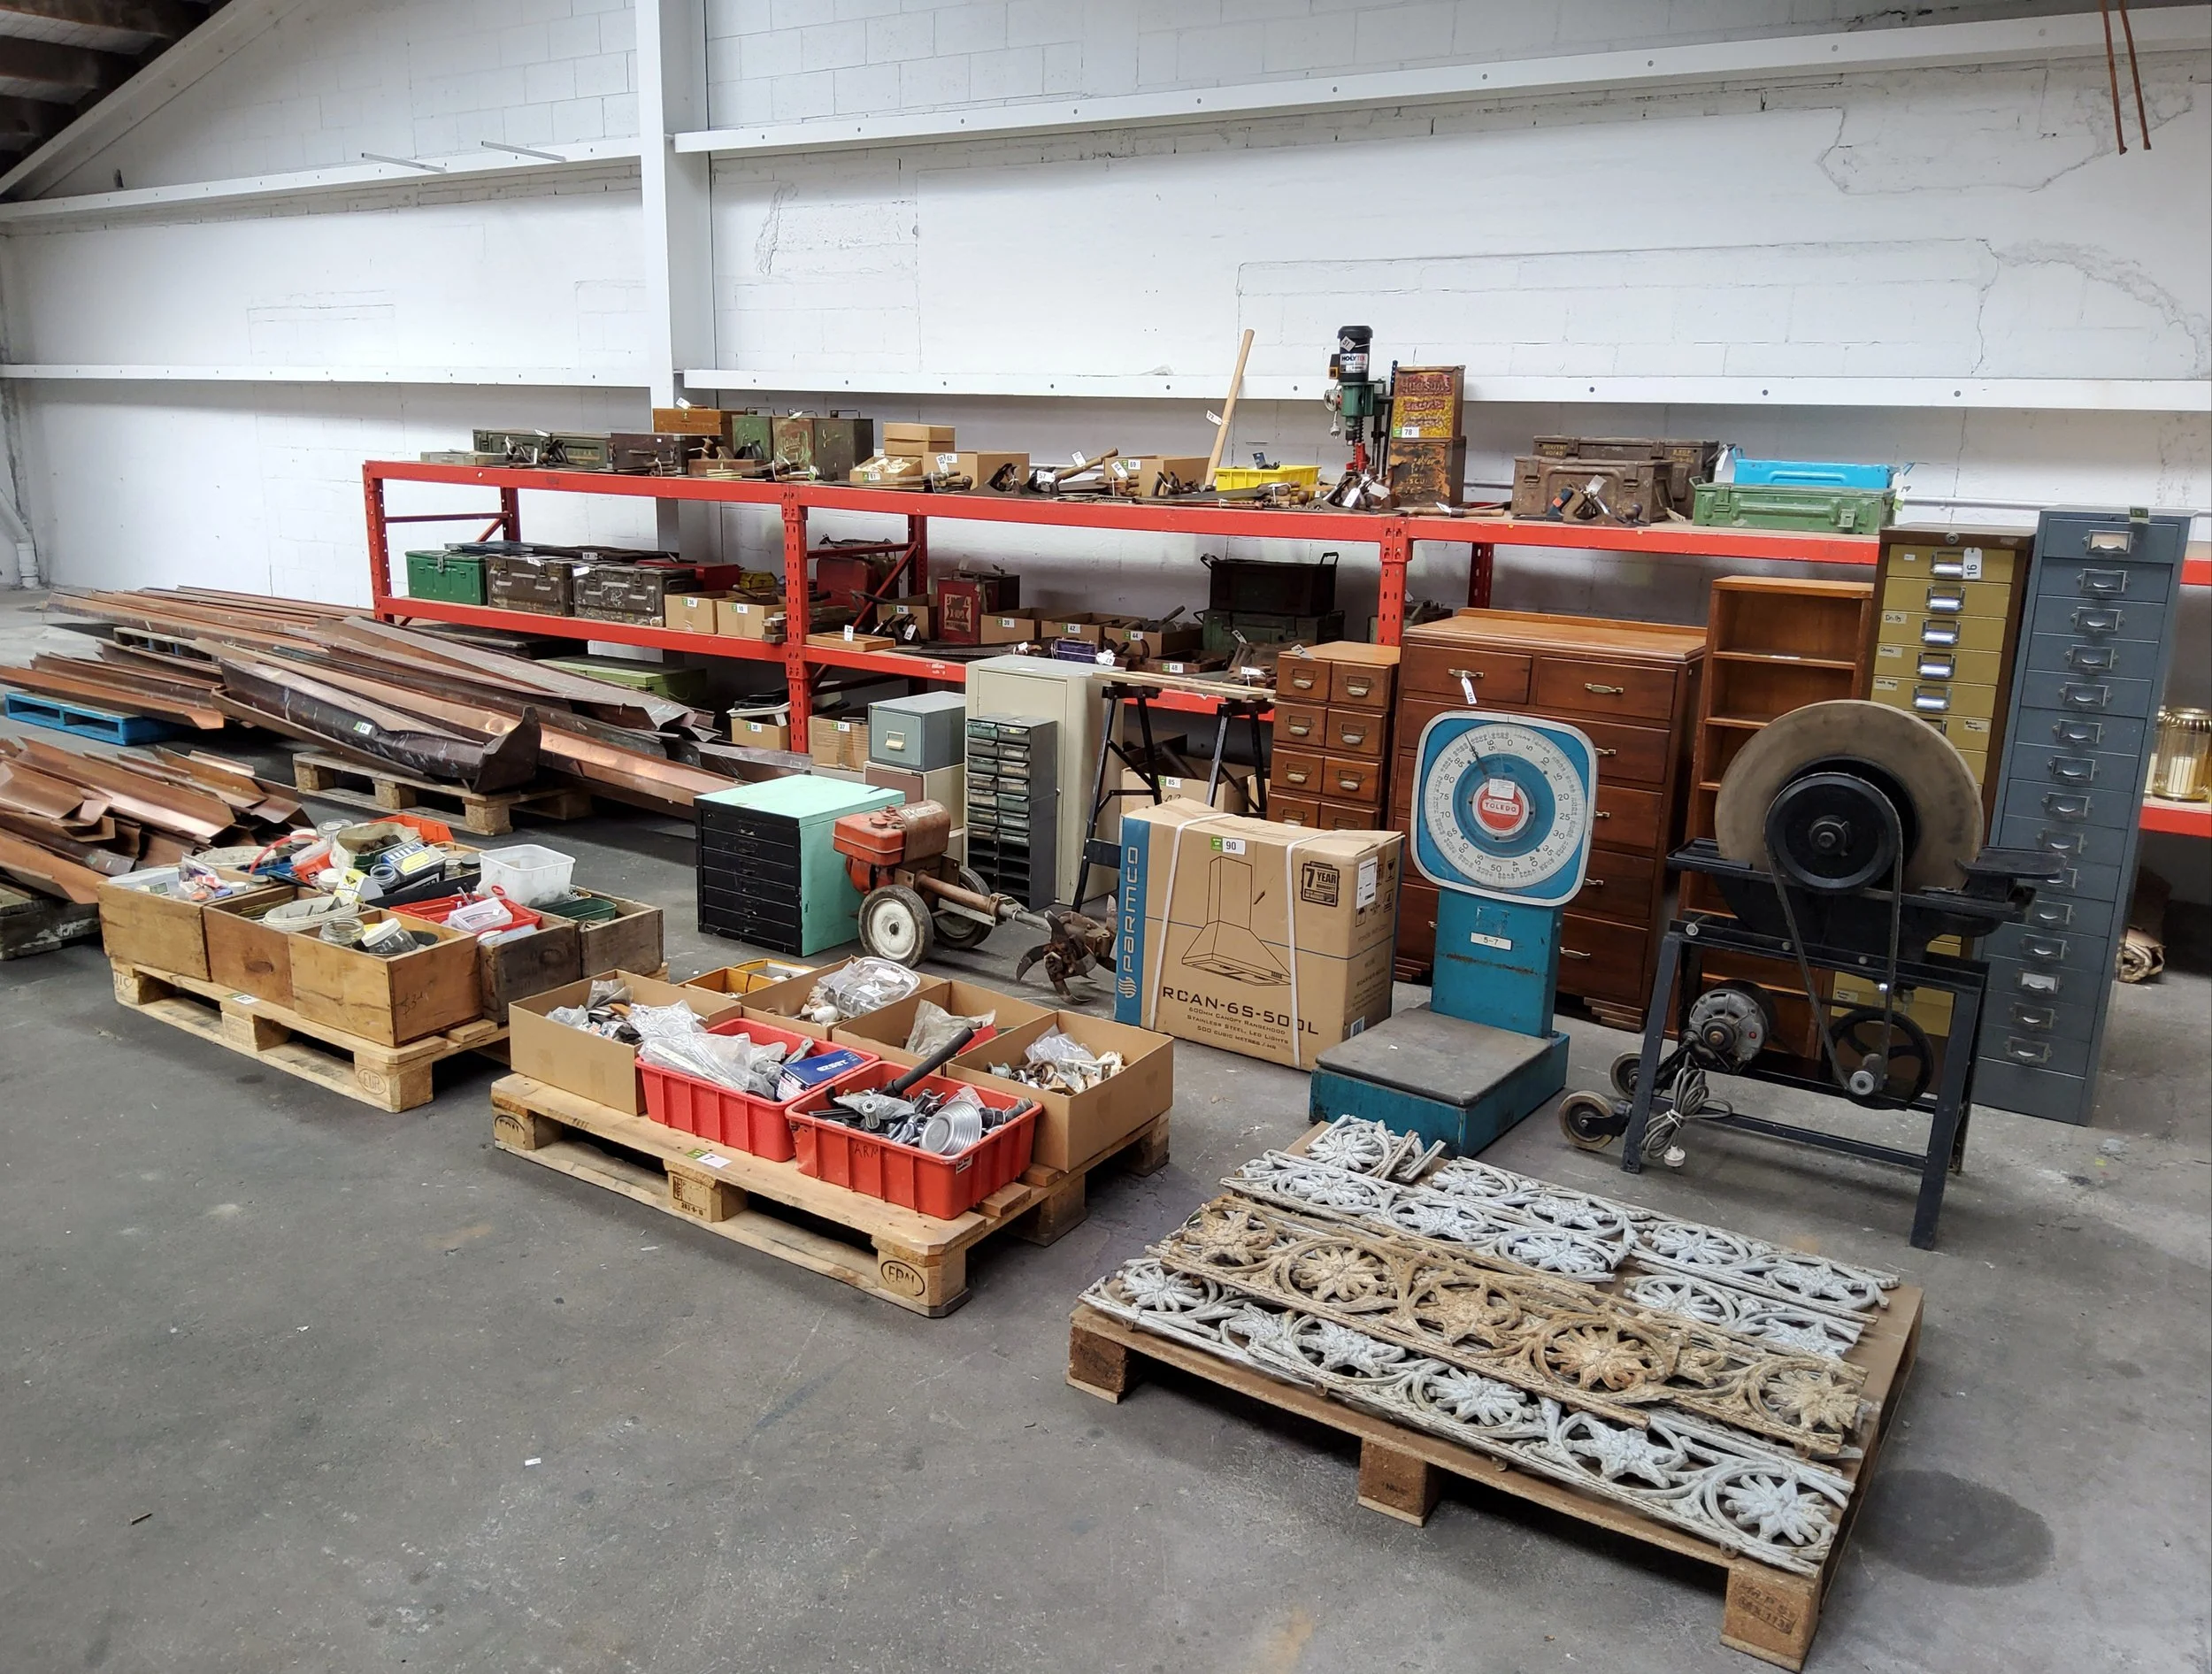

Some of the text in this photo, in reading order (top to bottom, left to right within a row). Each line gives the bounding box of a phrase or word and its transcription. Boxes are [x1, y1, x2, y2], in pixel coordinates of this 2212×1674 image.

[1966, 564, 1978, 576] 16
[1486, 740, 1495, 751] 95
[1454, 758, 1463, 768] 85
[1540, 756, 1549, 766] 10
[1443, 774, 1455, 783] 80
[1553, 772, 1563, 781] 15
[1485, 802, 1517, 812] TOLEDO
[1447, 827, 1458, 837] 65
[1553, 829, 1564, 840] 30
[1225, 841, 1237, 850] 90
[1459, 843, 1469, 854] 60
[1543, 845, 1554, 856] 35
[1474, 855, 1484, 866] 55
[1529, 856, 1538, 867] 40
[1512, 861, 1520, 872] 45
[1306, 867, 1336, 887] 7 YEAR
[363, 1071, 380, 1091] EUR
